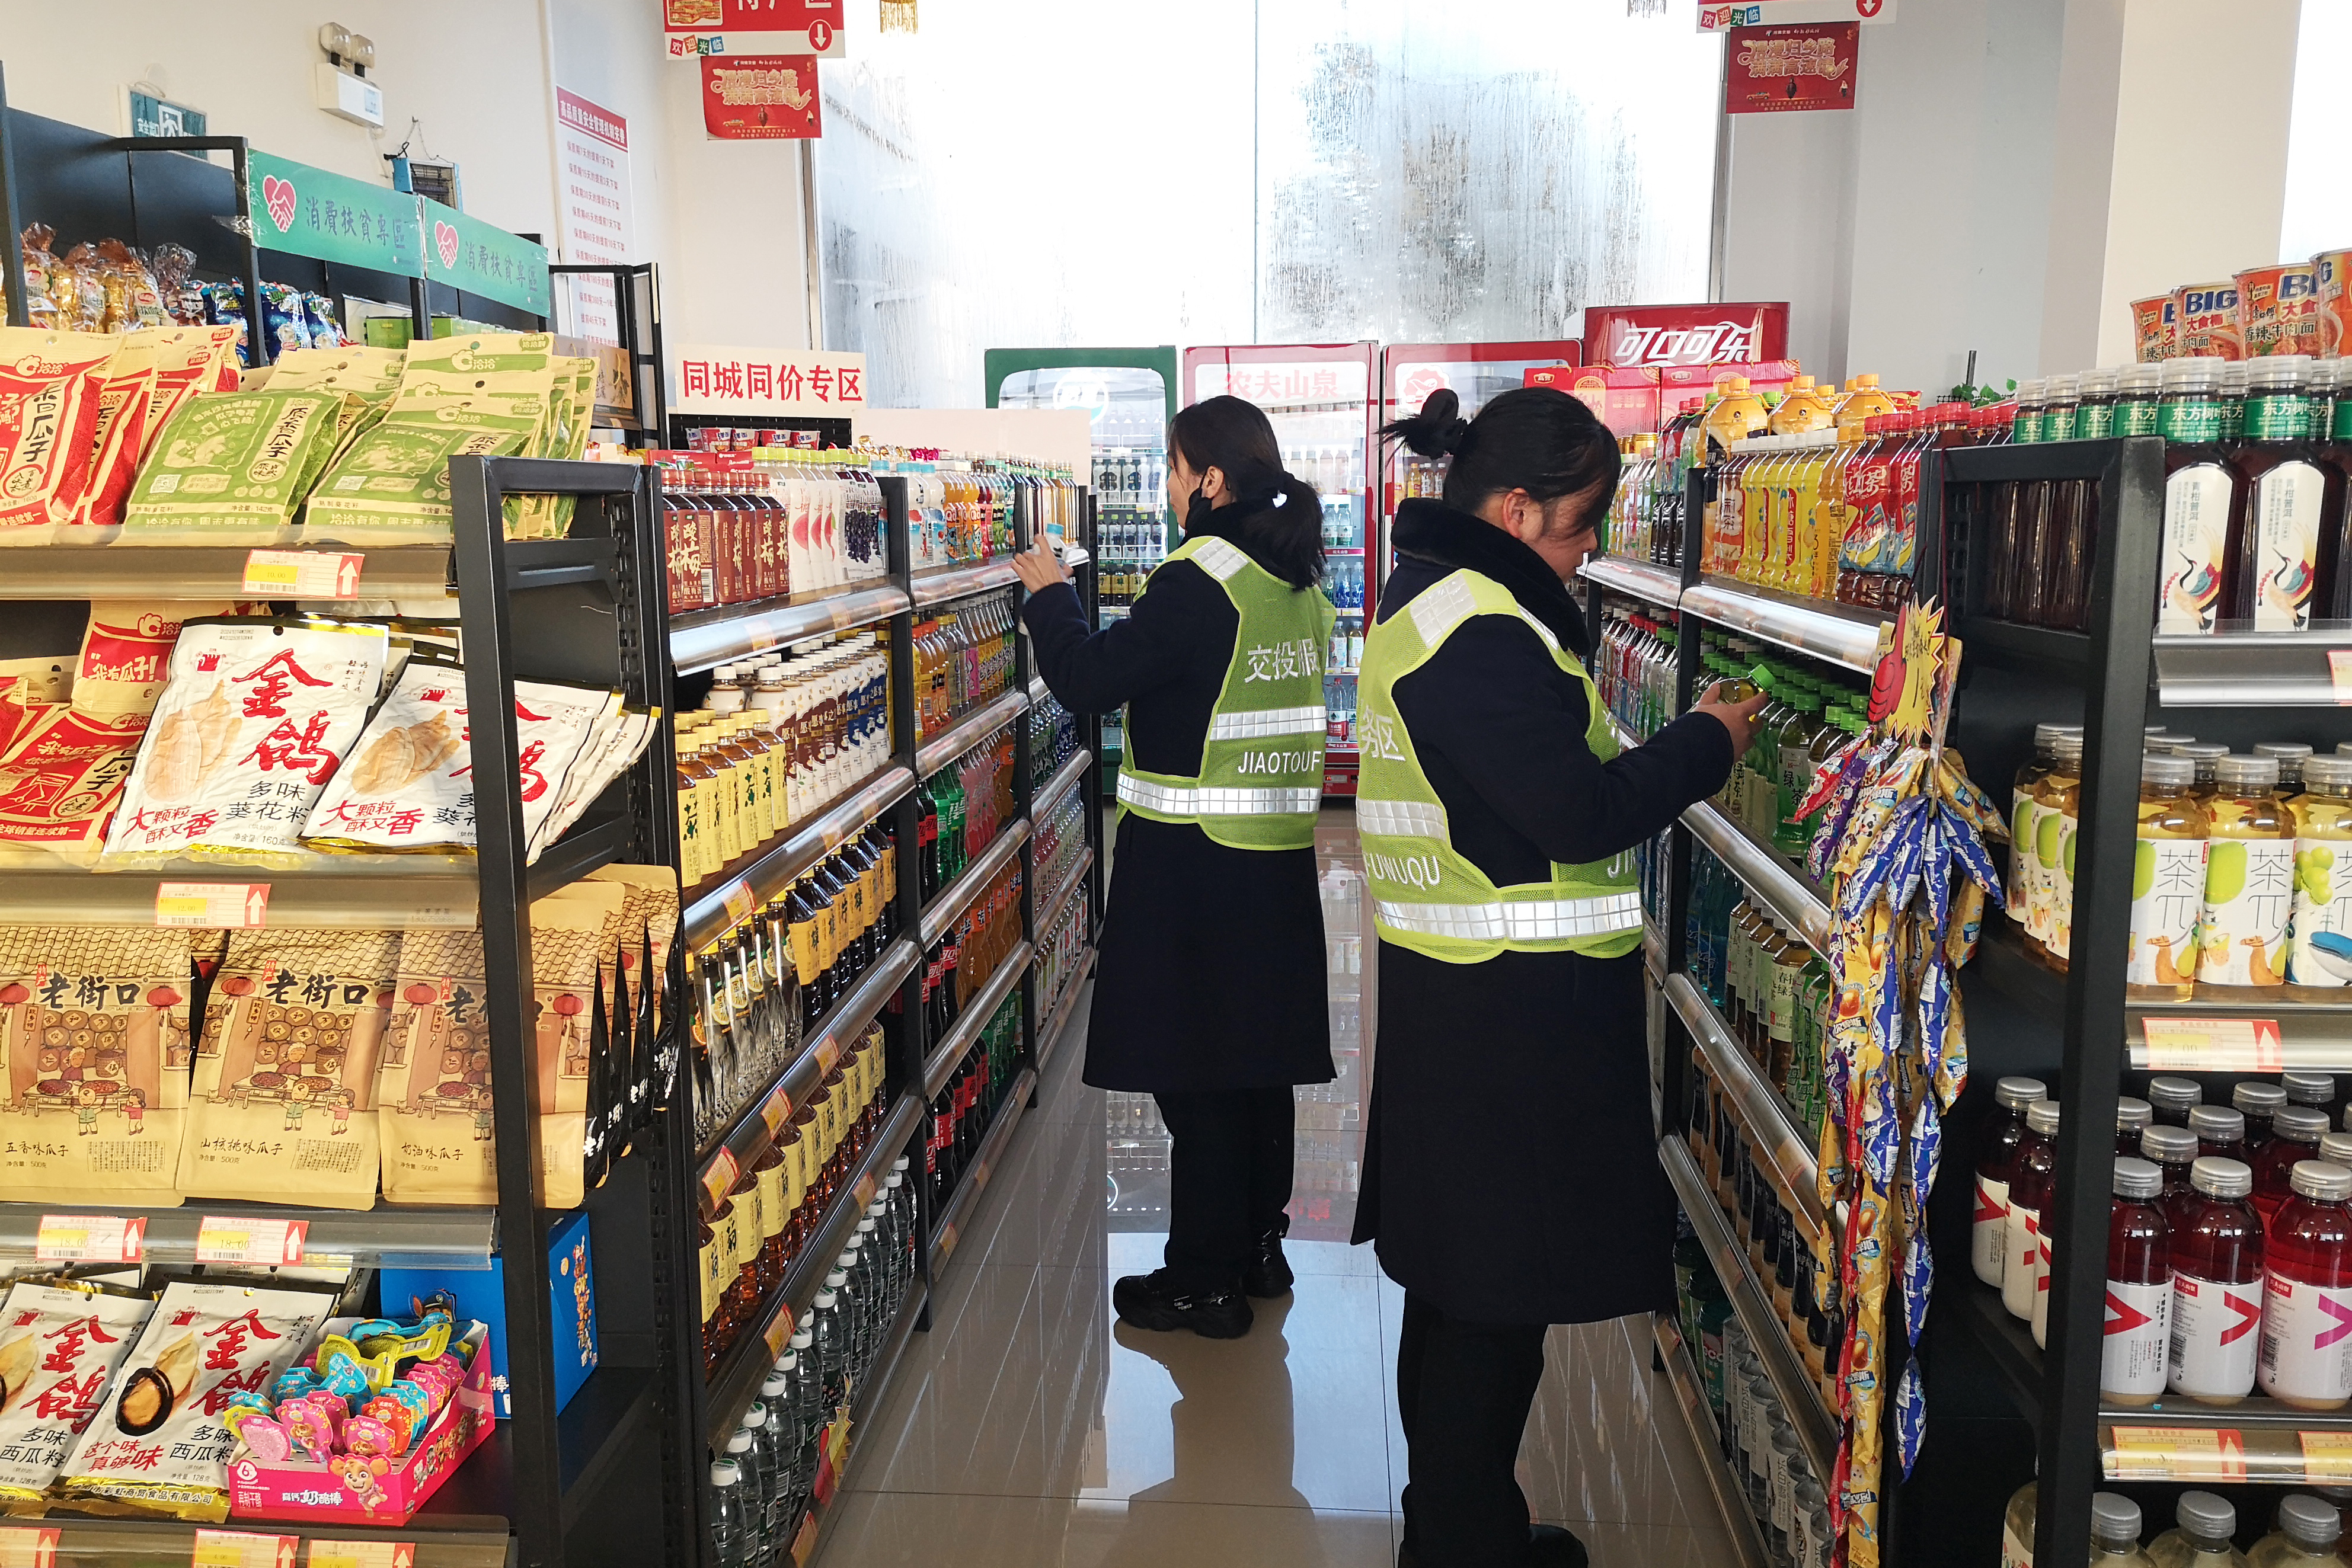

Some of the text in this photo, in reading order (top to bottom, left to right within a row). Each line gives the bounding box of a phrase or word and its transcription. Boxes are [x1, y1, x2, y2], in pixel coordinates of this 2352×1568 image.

[1702, 5, 1760, 27] 欢迎光临
[671, 36, 723, 55] 欢迎光临
[2185, 289, 2238, 315] BIG
[2244, 321, 2315, 343] 香辣牛肉面
[1613, 321, 1761, 364] 可口可乐
[37, 363, 64, 375] 洽洽
[473, 358, 496, 369] 洽洽
[683, 360, 863, 403] 同城同价专区
[1224, 369, 1338, 399] 农夫山泉
[455, 414, 481, 423] 洽洽
[330, 514, 381, 526] 洽洽有你
[681, 520, 702, 578] 酸梅
[760, 520, 774, 569] 酸梅
[267, 571, 286, 579] 10.00
[1245, 638, 1321, 683] 交投服
[231, 648, 342, 785] 金鸽
[1238, 751, 1322, 774] JIAOTOUF
[248, 781, 307, 801] 多味
[122, 806, 190, 837] 大颗粒
[319, 800, 397, 825] 大颗粒
[344, 807, 426, 836] 酥又香
[145, 809, 219, 844] 酥又香
[261, 834, 287, 845] 160克
[39, 970, 142, 1011] 老街口
[266, 968, 370, 1010] 老街口
[5, 1140, 69, 1157] 五香味瓜子
[200, 1137, 283, 1156] 山核桃味瓜子
[401, 1142, 464, 1161] 奶油味瓜子
[30, 1160, 47, 1169] 500克
[220, 1156, 241, 1164] 500克
[59, 1237, 89, 1248] 18.00
[220, 1239, 250, 1250] 18.00
[20, 1314, 119, 1435] 金鸽
[492, 1375, 509, 1393] 棒
[21, 1427, 68, 1446] 多味
[190, 1424, 234, 1443] 多味
[1, 1445, 66, 1469] 西瓜籽
[82, 1440, 140, 1460] 这个味
[88, 1444, 165, 1473] 真够味
[20, 1476, 37, 1485] 128克
[193, 1474, 210, 1482] 128克
[282, 1489, 343, 1506] 高钙奶酪棒
